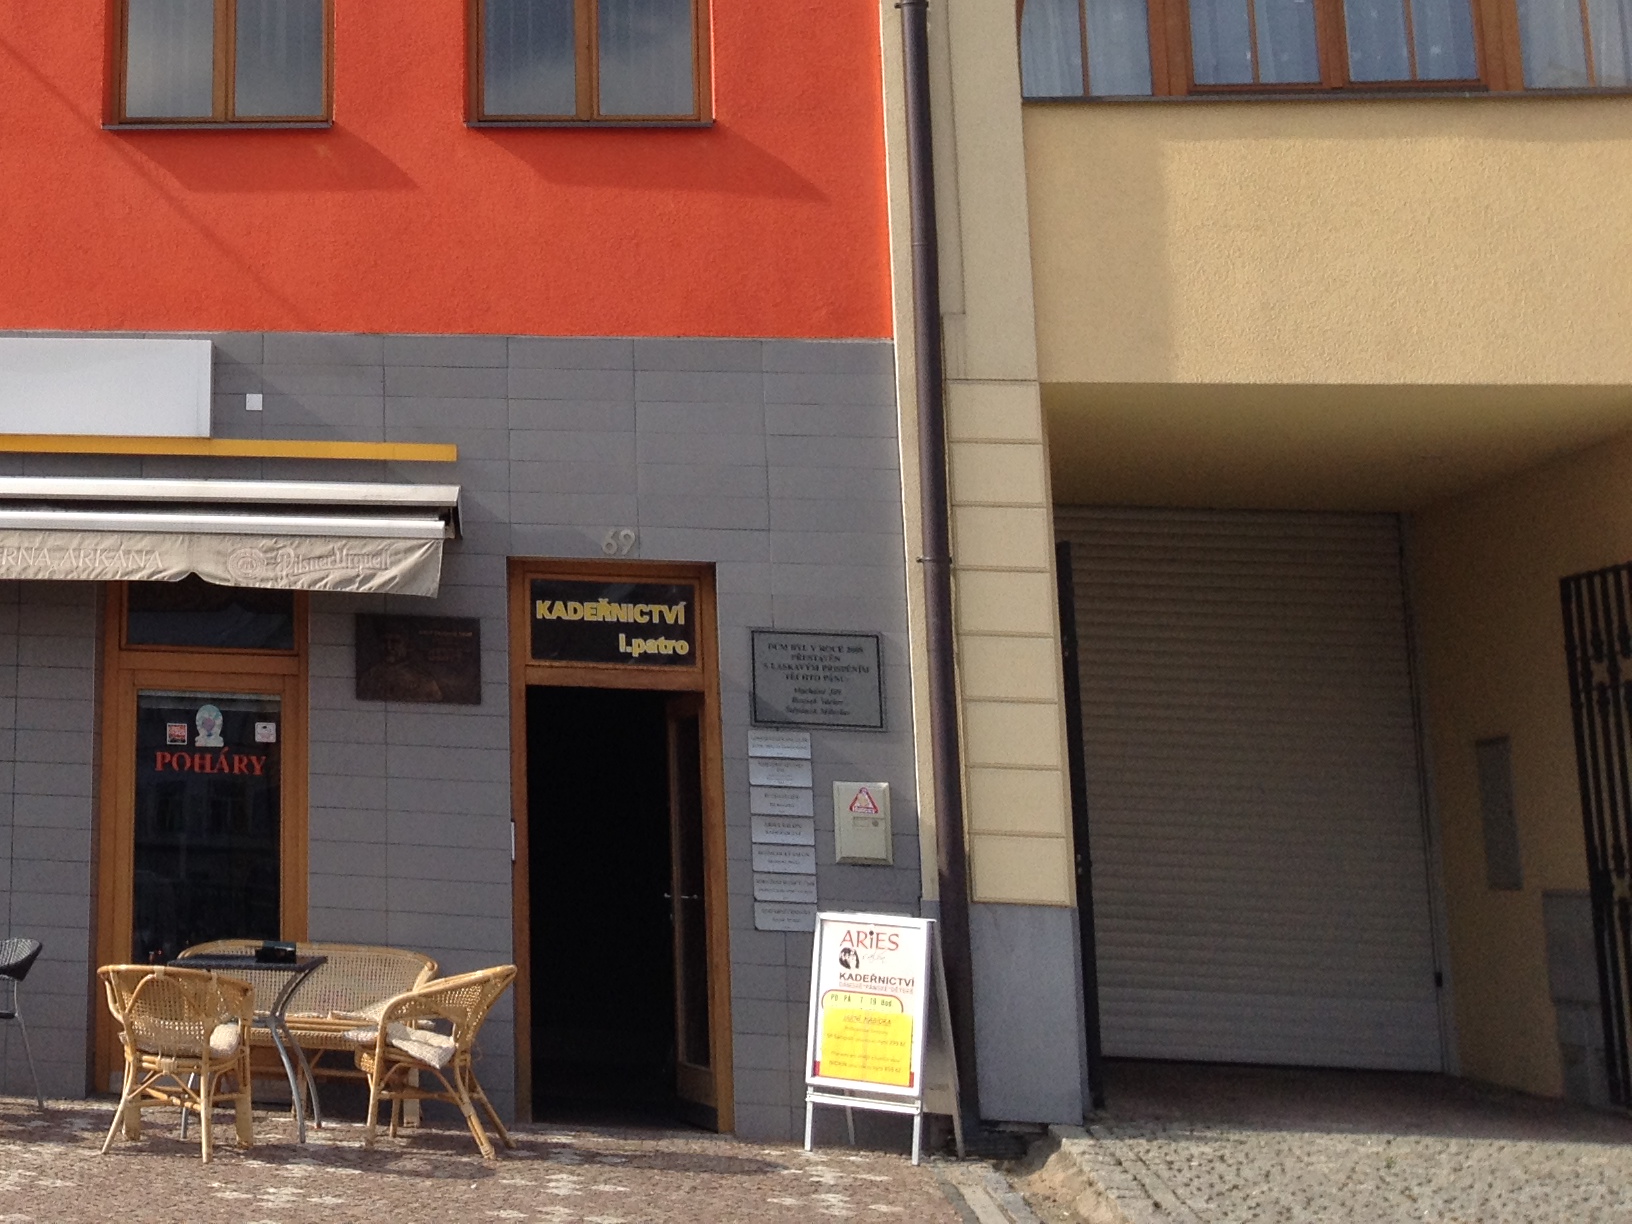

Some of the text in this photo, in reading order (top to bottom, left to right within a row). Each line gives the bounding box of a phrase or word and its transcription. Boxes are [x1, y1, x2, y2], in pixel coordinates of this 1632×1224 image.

[601, 528, 636, 556] 69
[275, 545, 390, 582] Pilsner Urquell
[536, 598, 686, 625] KADEŘNICTVÍ
[154, 746, 267, 776] POHÁRY
[840, 972, 915, 987] KADEŘNICTVÍ
